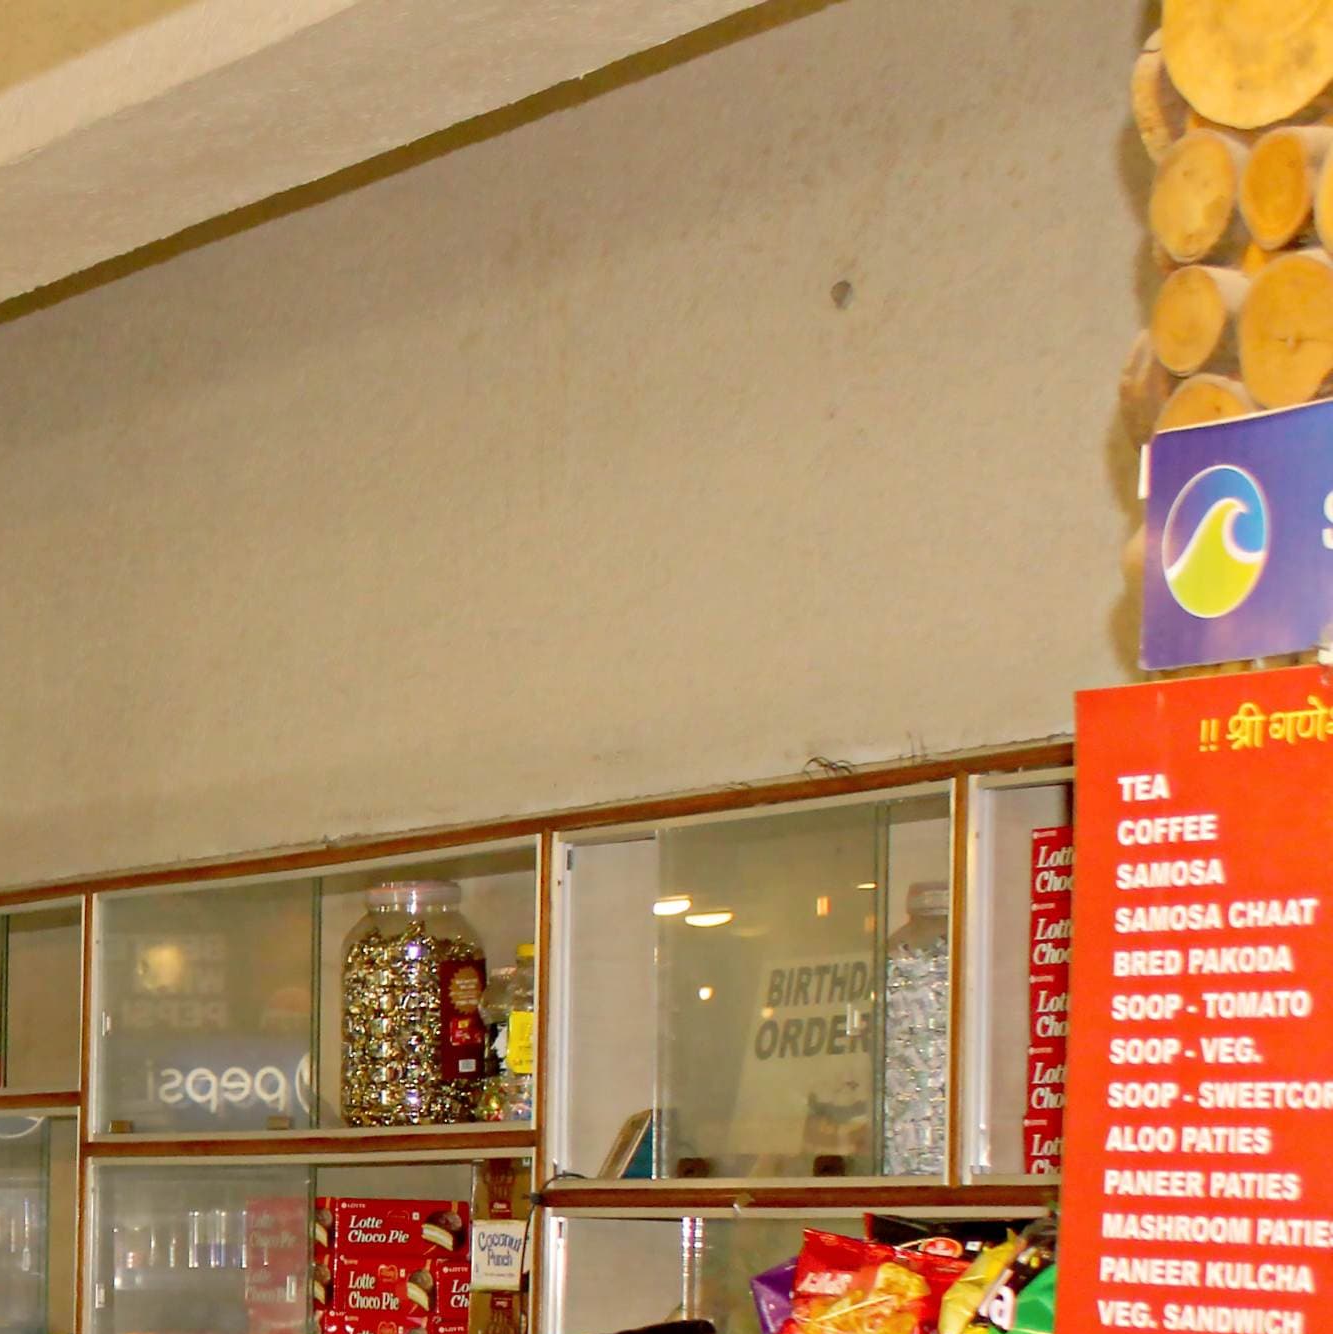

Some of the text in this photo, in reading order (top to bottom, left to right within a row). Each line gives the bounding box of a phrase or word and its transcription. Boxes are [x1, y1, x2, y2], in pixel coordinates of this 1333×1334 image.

[1226, 702, 1264, 750] श्री
[1117, 773, 1171, 802] TEA
[1116, 813, 1218, 846] COFFEE
[1115, 858, 1226, 890] SAMOSA
[1114, 897, 1320, 934] SAMOSA CHAAT
[1113, 944, 1295, 977] BRED PAKODA
[1111, 993, 1184, 1021] SOOP
[1201, 989, 1313, 1019] TOMATO
[1108, 1037, 1182, 1065] SOOP
[1199, 1036, 1264, 1064] VEG.
[1107, 1081, 1180, 1109] SOOP
[1104, 1125, 1273, 1155] ALOO PATIES
[1103, 1169, 1302, 1201] PANEER PATIES
[347, 1230, 410, 1244] Choco Pie
[349, 1214, 383, 1229] Lotte
[1101, 1212, 1253, 1245] MASHROOM
[348, 1271, 376, 1289] Lotte
[1099, 1255, 1316, 1294] PANEER KULCHA
[348, 1291, 400, 1310] Choco Pie
[1097, 1299, 1158, 1329] VEG.
